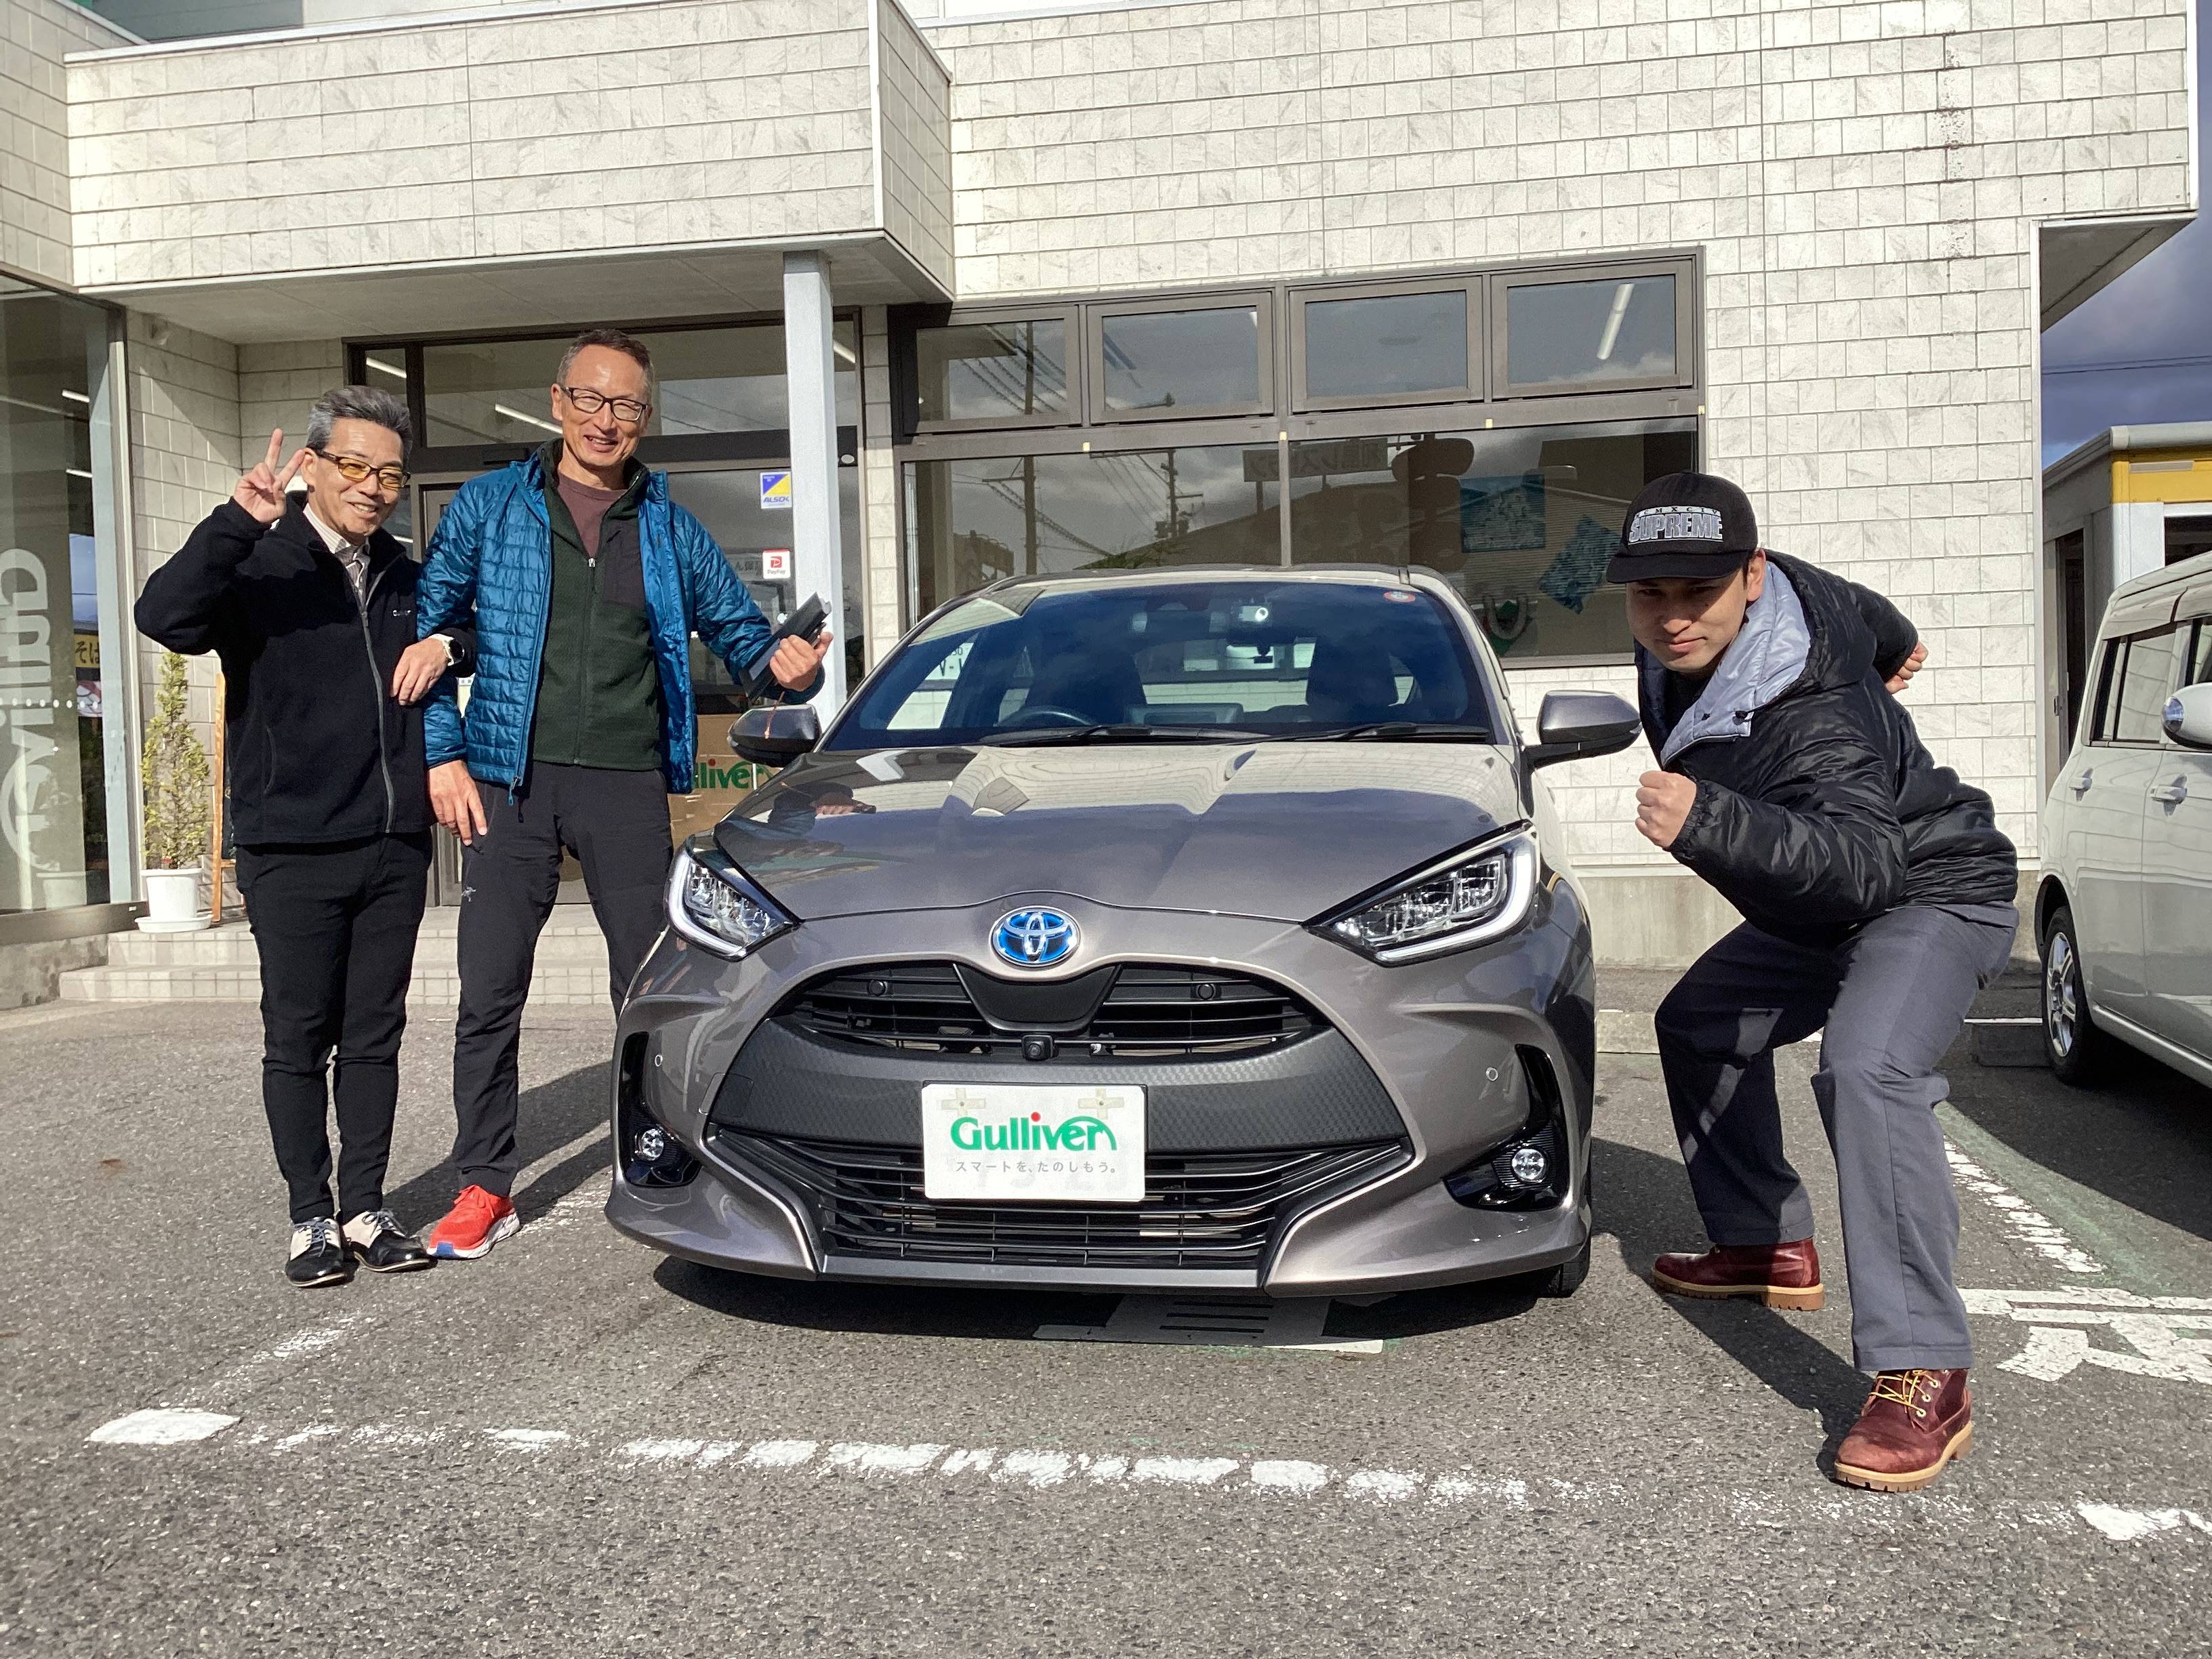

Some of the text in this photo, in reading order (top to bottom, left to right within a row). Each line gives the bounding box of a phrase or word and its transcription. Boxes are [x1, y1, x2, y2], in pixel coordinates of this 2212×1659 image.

[1629, 513, 1723, 543] SUPREME
[951, 1111, 1118, 1151] Gulliver
[956, 1160, 1116, 1174] スマートを、たのしもう。
